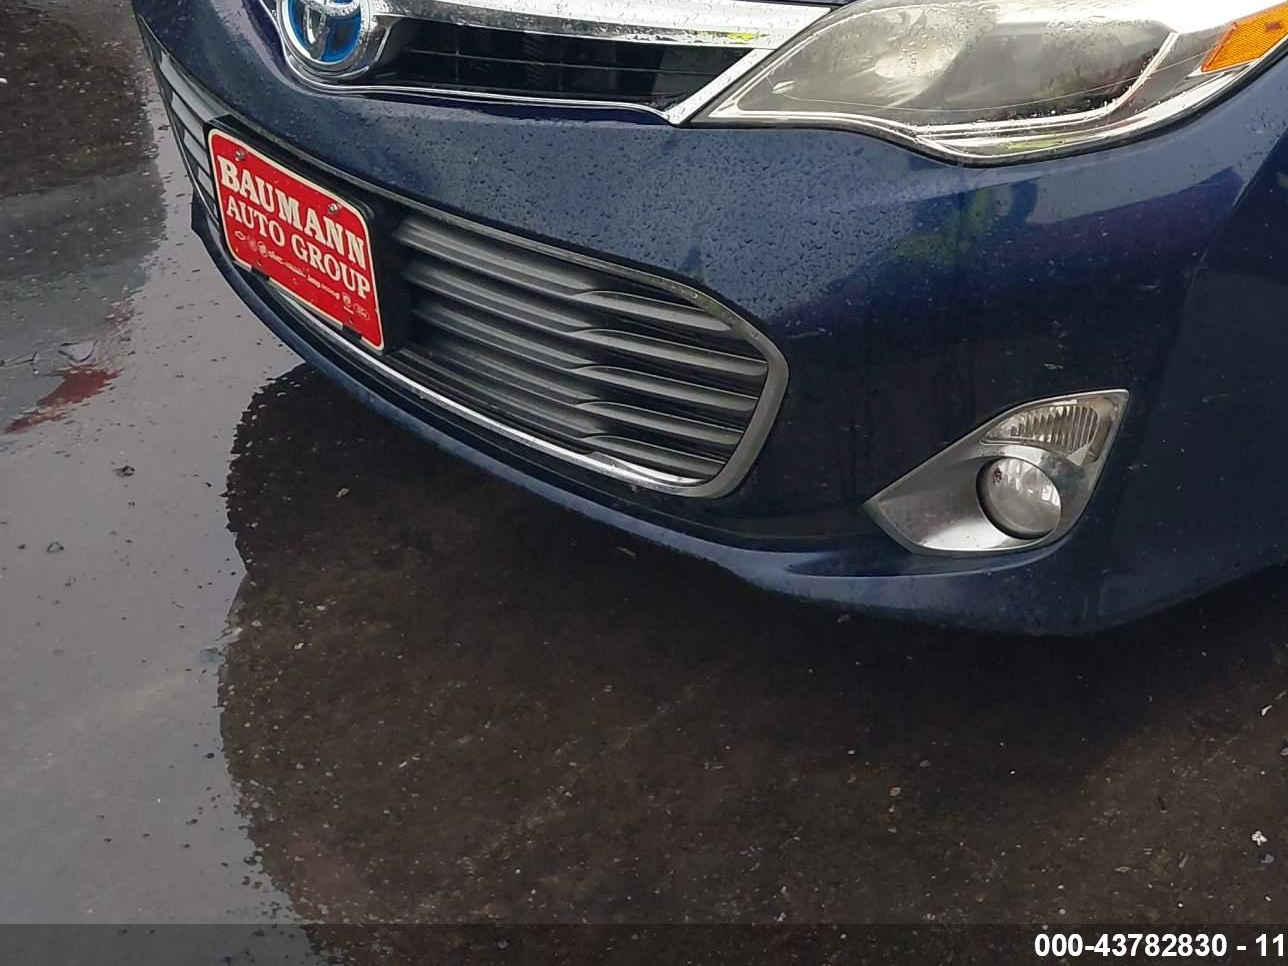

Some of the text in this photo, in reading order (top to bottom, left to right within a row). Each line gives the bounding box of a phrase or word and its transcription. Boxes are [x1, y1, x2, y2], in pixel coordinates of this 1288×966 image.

[218, 155, 366, 270] BAUMANN
[226, 196, 286, 247] AUTO
[291, 233, 370, 299] GROUP
